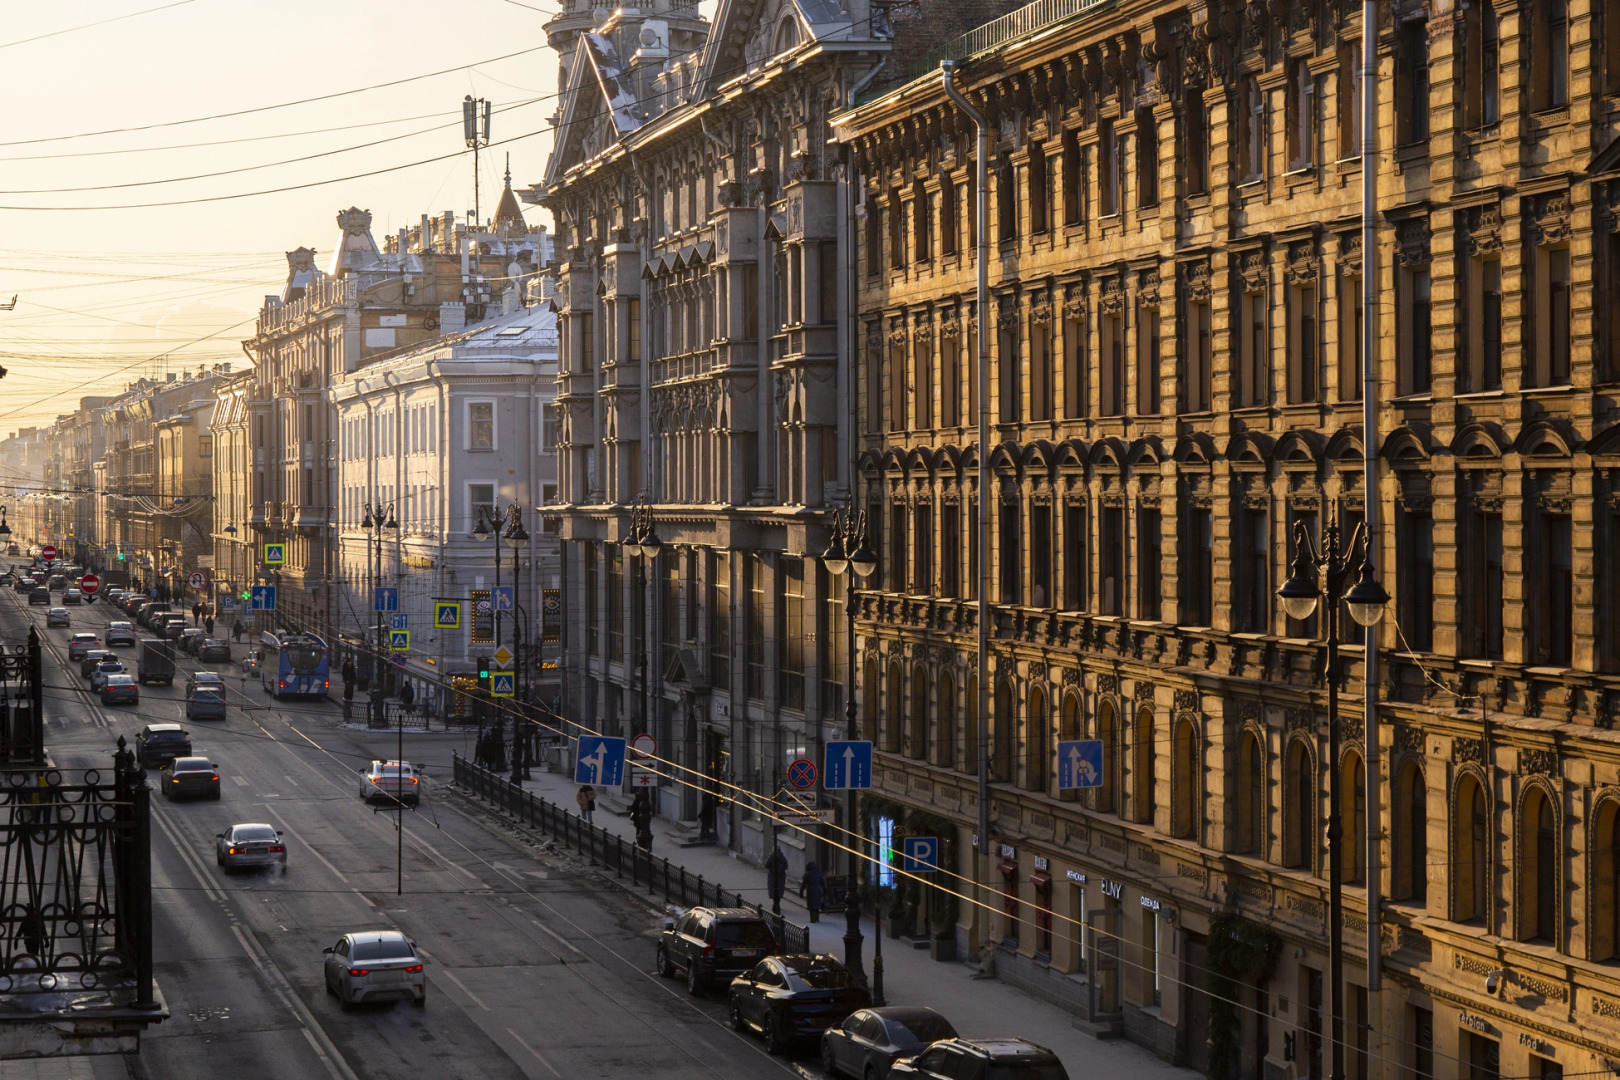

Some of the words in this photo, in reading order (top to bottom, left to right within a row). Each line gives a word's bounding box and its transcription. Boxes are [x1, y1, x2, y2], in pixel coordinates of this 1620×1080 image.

[914, 841, 932, 868] P
[1066, 869, 1086, 883] ЖЕНСКАЯ
[1101, 878, 1122, 899] ELNY
[1140, 896, 1160, 910] ОДЕЖДА
[1457, 1013, 1485, 1031] serbian
[1518, 1033, 1537, 1050] food
